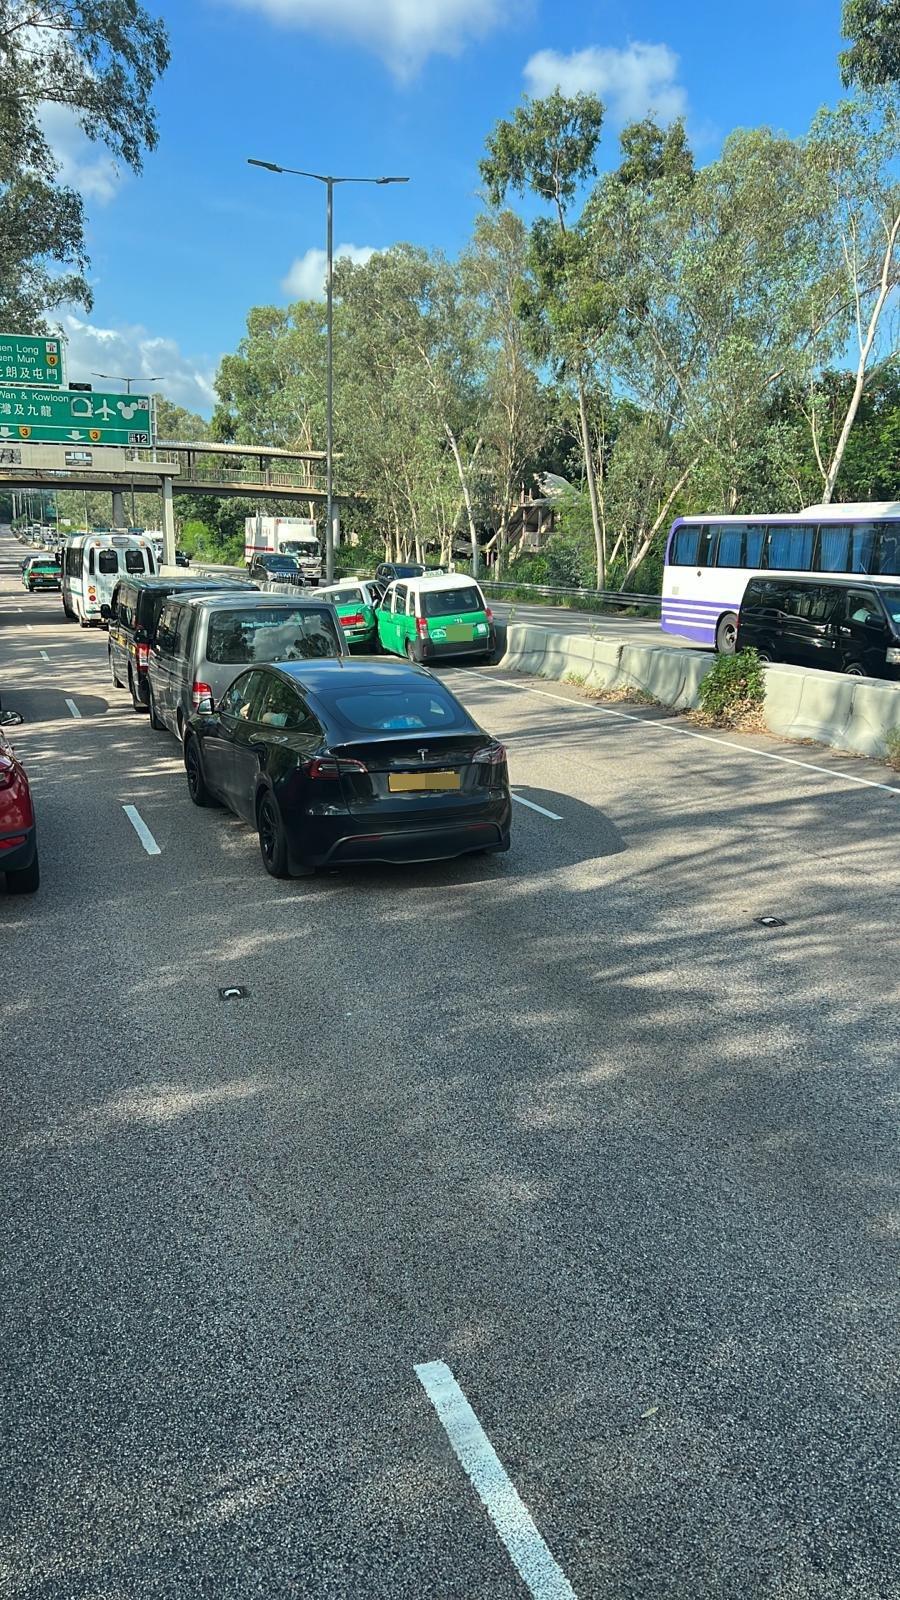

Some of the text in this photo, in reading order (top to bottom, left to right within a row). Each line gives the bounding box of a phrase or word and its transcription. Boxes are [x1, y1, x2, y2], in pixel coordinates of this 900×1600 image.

[16, 344, 39, 356] Long
[17, 354, 36, 363] Mun
[49, 357, 55, 365] 9
[21, 391, 28, 400] &
[32, 392, 69, 403] Kowloon
[22, 428, 28, 436] 3
[92, 431, 98, 439] 3
[136, 434, 147, 443] 12
